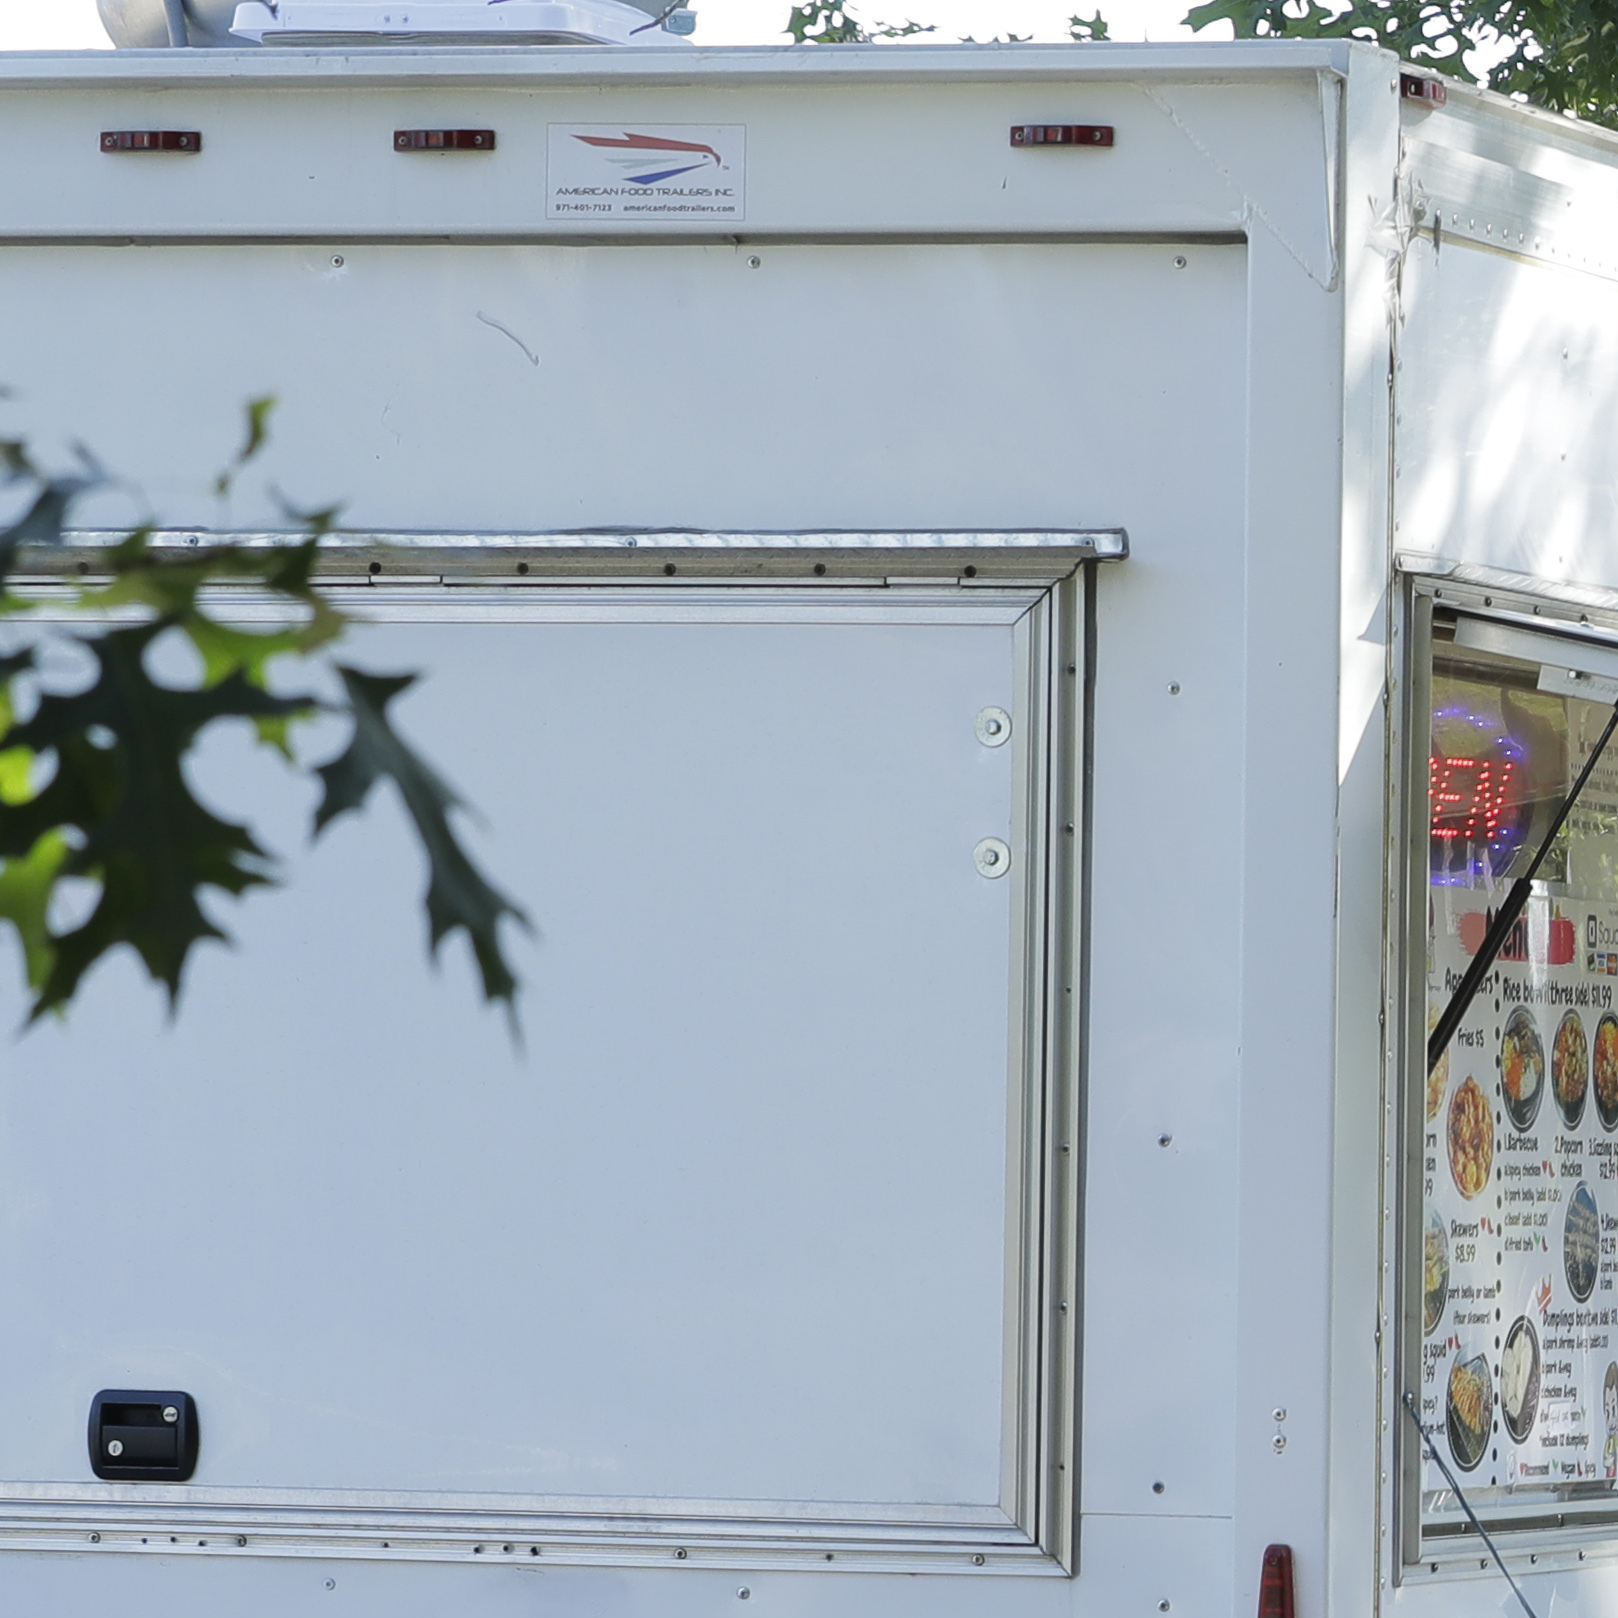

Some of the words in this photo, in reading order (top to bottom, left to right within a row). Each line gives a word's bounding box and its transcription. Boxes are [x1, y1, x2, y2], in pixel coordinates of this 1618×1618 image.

[556, 187, 619, 196] AMERICAN
[620, 187, 653, 196] FOOD
[657, 187, 712, 196] TRAILERS
[715, 187, 735, 196] INC.
[555, 204, 612, 212] 971-401-7123
[623, 204, 735, 212] americanfoodtrailers.com
[1503, 976, 1521, 1003] Rice
[1458, 1028, 1474, 1047] Fries
[1560, 1162, 1582, 1178] chicken
[1450, 1218, 1479, 1239] Skewers
[1455, 1243, 1476, 1263] $8.99
[1462, 1285, 1475, 1303] belly
[1476, 1288, 1482, 1298] or
[1483, 1286, 1496, 1299] lamb
[1542, 1309, 1575, 1333] Dumplings
[1429, 1342, 1447, 1365] squid
